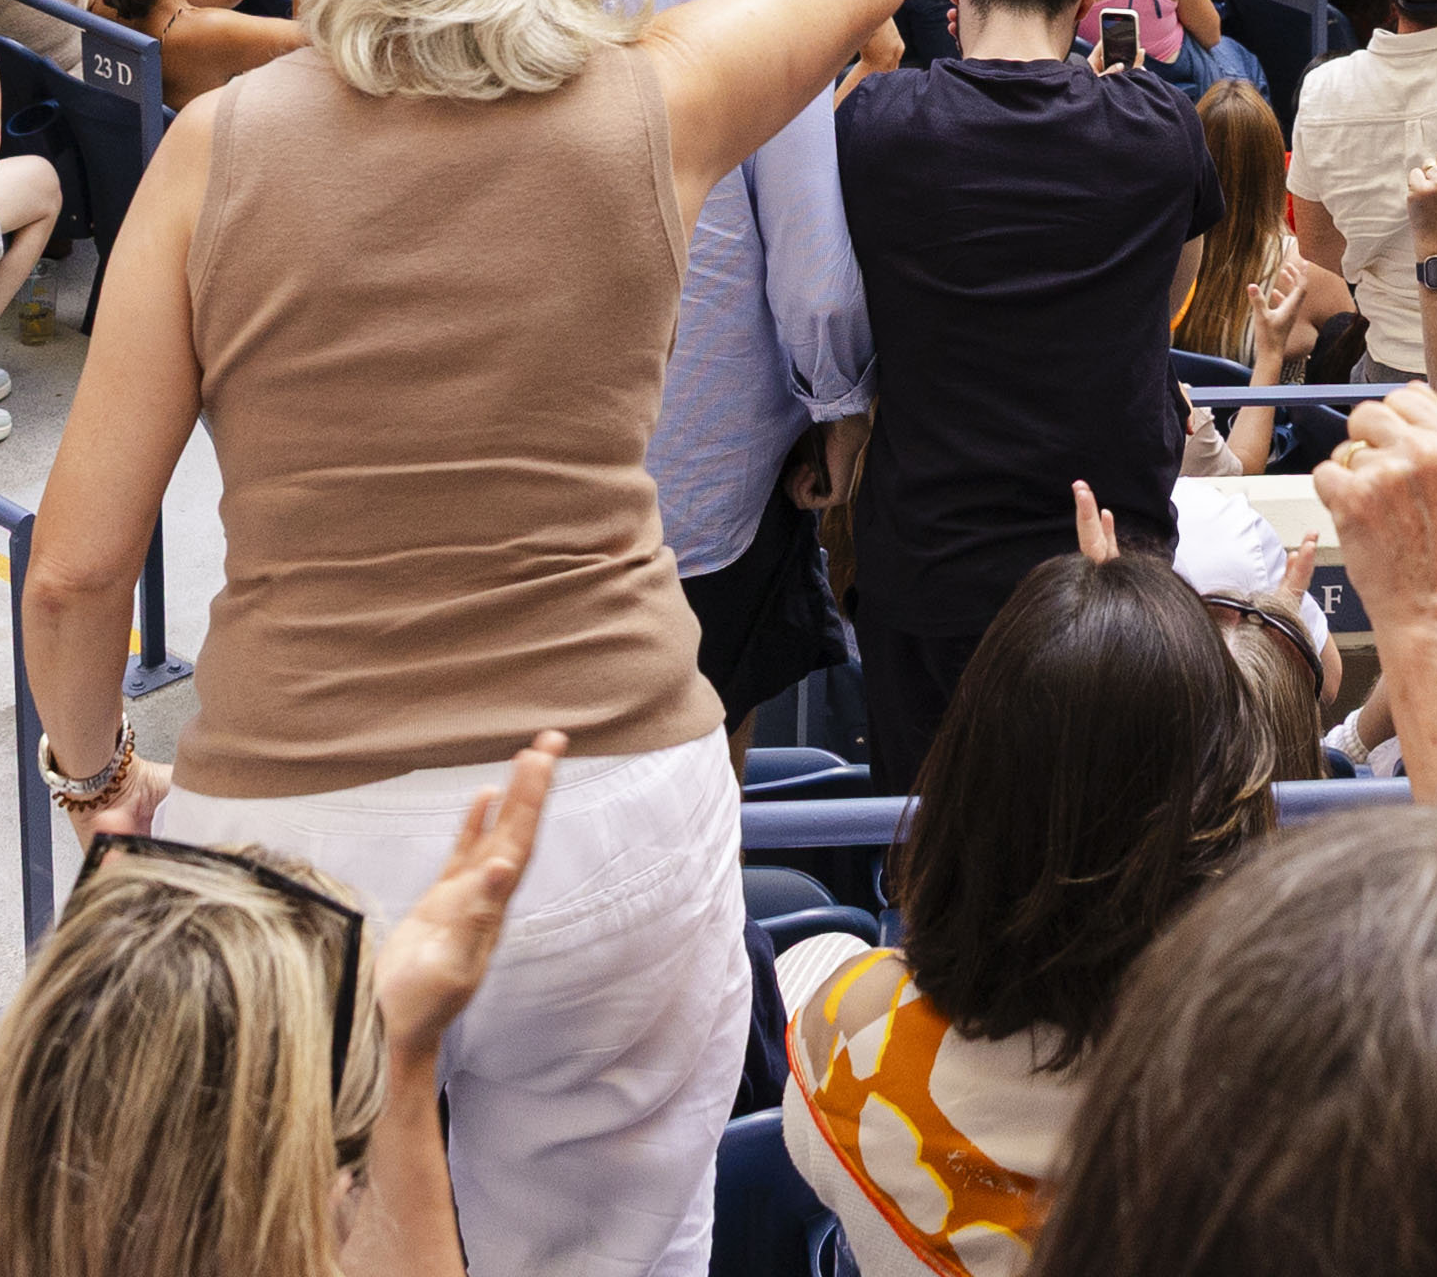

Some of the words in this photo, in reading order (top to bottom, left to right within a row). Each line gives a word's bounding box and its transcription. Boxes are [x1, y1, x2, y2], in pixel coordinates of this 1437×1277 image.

[93, 53, 113, 80] 23
[116, 60, 133, 86] D
[1321, 585, 1343, 615] F
